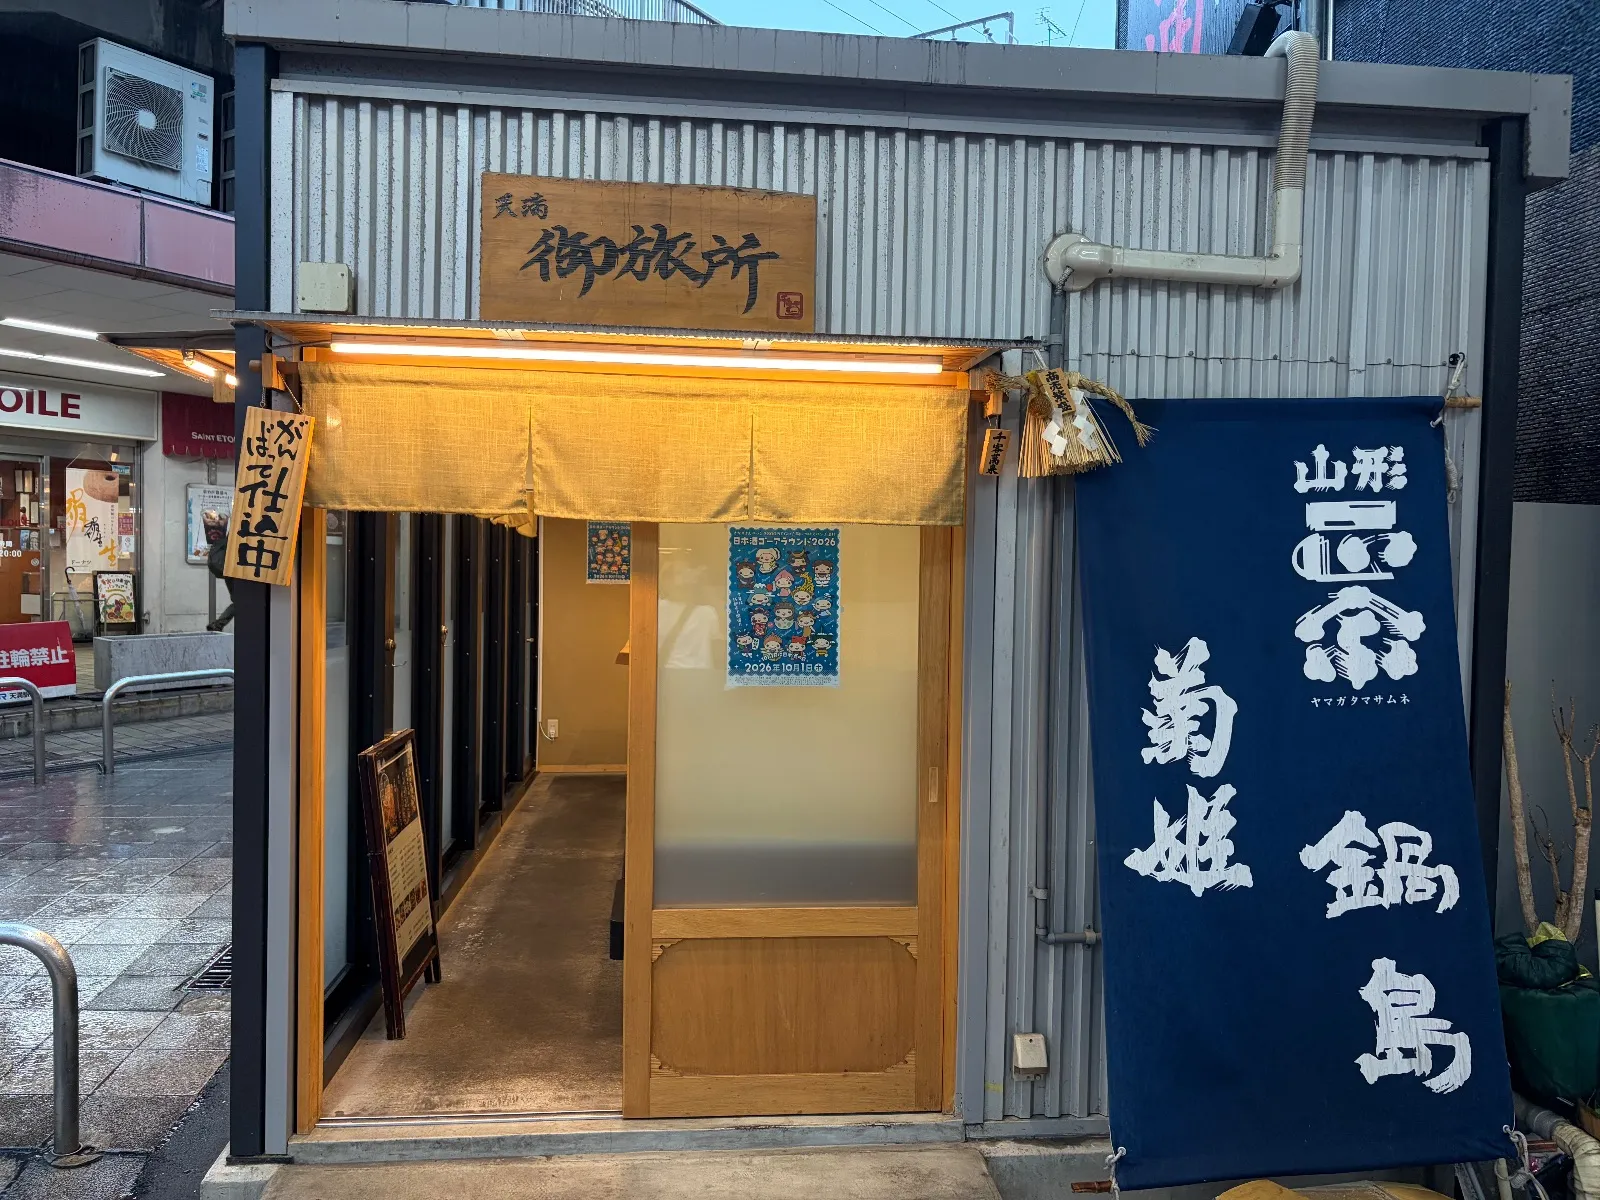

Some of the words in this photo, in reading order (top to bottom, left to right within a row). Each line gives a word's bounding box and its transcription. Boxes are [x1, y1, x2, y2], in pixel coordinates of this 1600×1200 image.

[519, 222, 780, 316] 御旅所
[191, 431, 216, 441] SAINT
[1310, 693, 1411, 708] ヤマガタマサムネ
